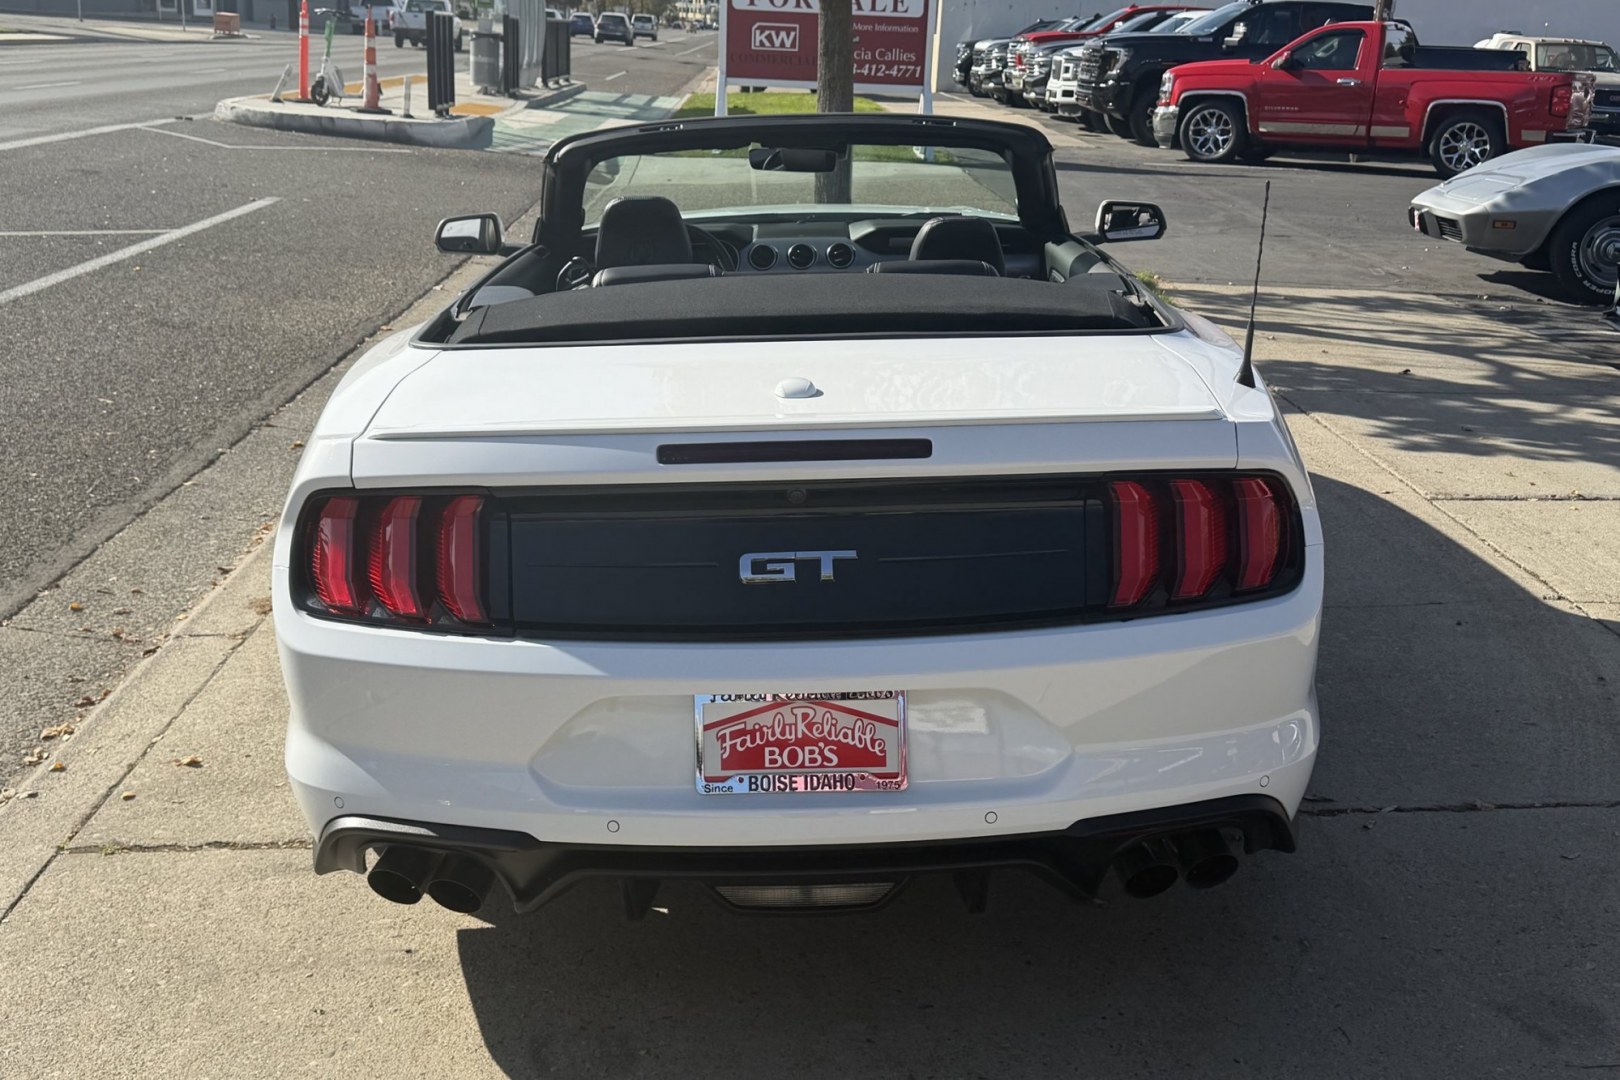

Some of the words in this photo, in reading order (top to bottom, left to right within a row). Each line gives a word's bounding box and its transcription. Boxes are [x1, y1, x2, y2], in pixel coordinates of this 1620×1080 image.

[853, 23, 873, 32] More
[875, 23, 918, 33] Information
[755, 30, 796, 48] KW
[875, 48, 916, 62] Callies
[740, 550, 858, 584] GT
[716, 711, 796, 760] Fairly
[791, 705, 886, 757] Reliable
[764, 742, 838, 768] BOB'S
[704, 783, 734, 793] Since
[748, 774, 799, 792] BOISE
[803, 773, 855, 791] IDAHO
[876, 780, 901, 790] 1975
